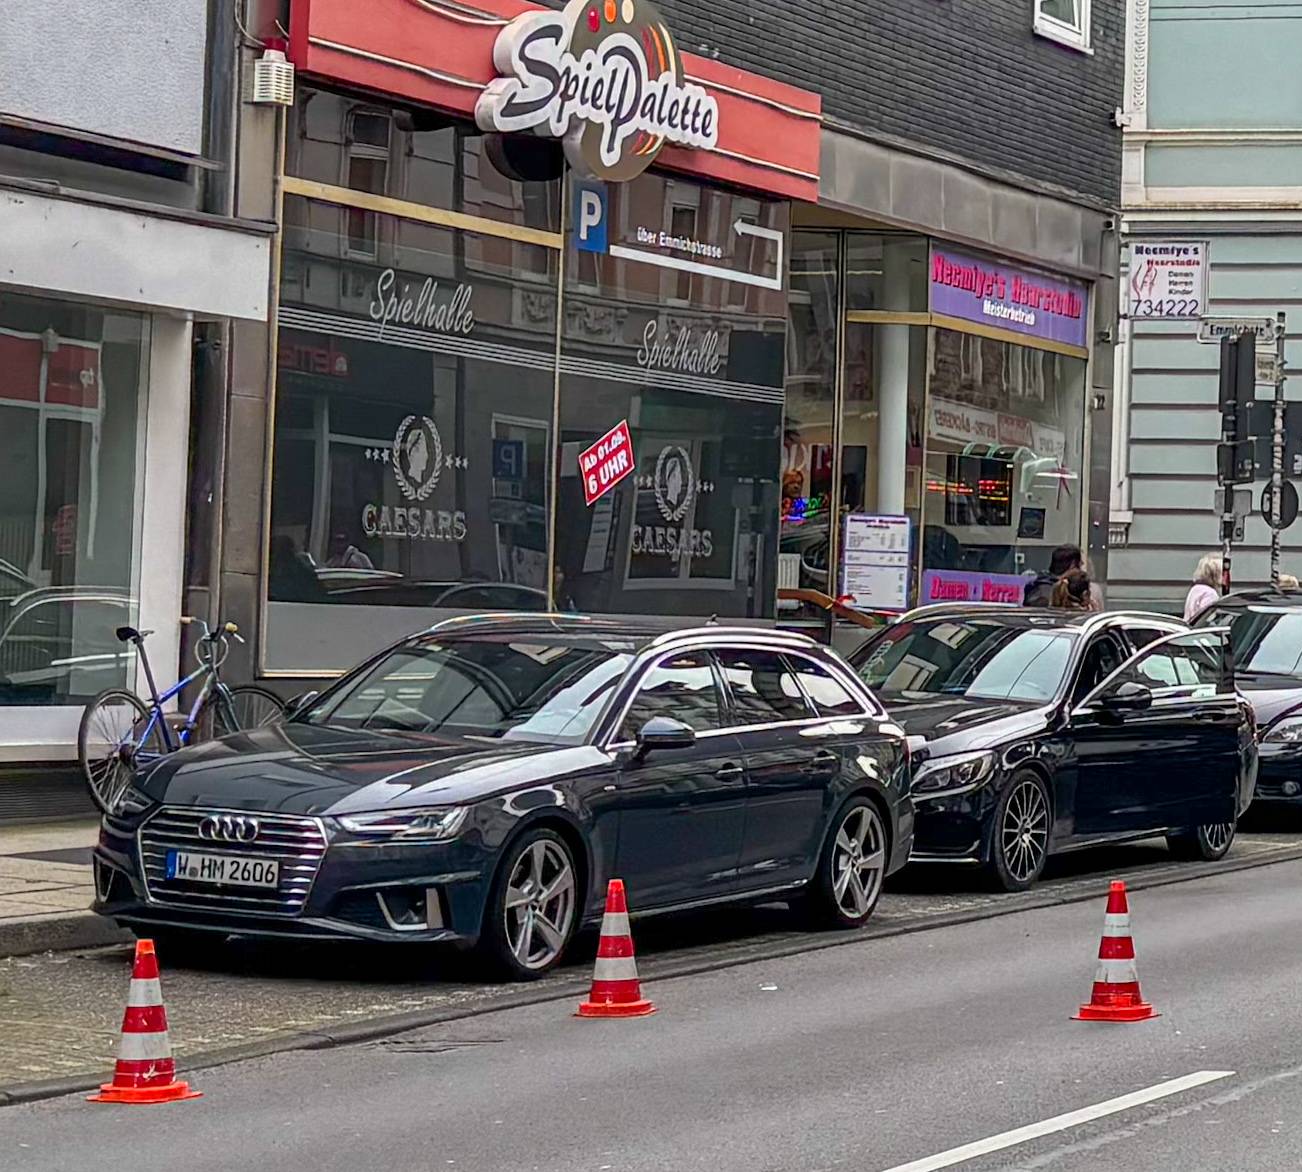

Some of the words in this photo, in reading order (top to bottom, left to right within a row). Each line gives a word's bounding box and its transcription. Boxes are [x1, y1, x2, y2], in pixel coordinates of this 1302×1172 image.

[580, 190, 602, 240] P
[637, 227, 657, 244] über
[659, 232, 722, 258] Emmichstrasse
[370, 269, 475, 341] Spielhalle
[1132, 299, 1199, 316] 734222
[637, 320, 722, 384] Spielhalle
[588, 474, 598, 494] 6
[599, 449, 629, 485] UHR
[362, 504, 467, 541] CAESARS
[631, 526, 713, 557] CAESARS
[178, 853, 188, 877] W
[200, 859, 225, 880] HM
[229, 860, 275, 883] 2606
